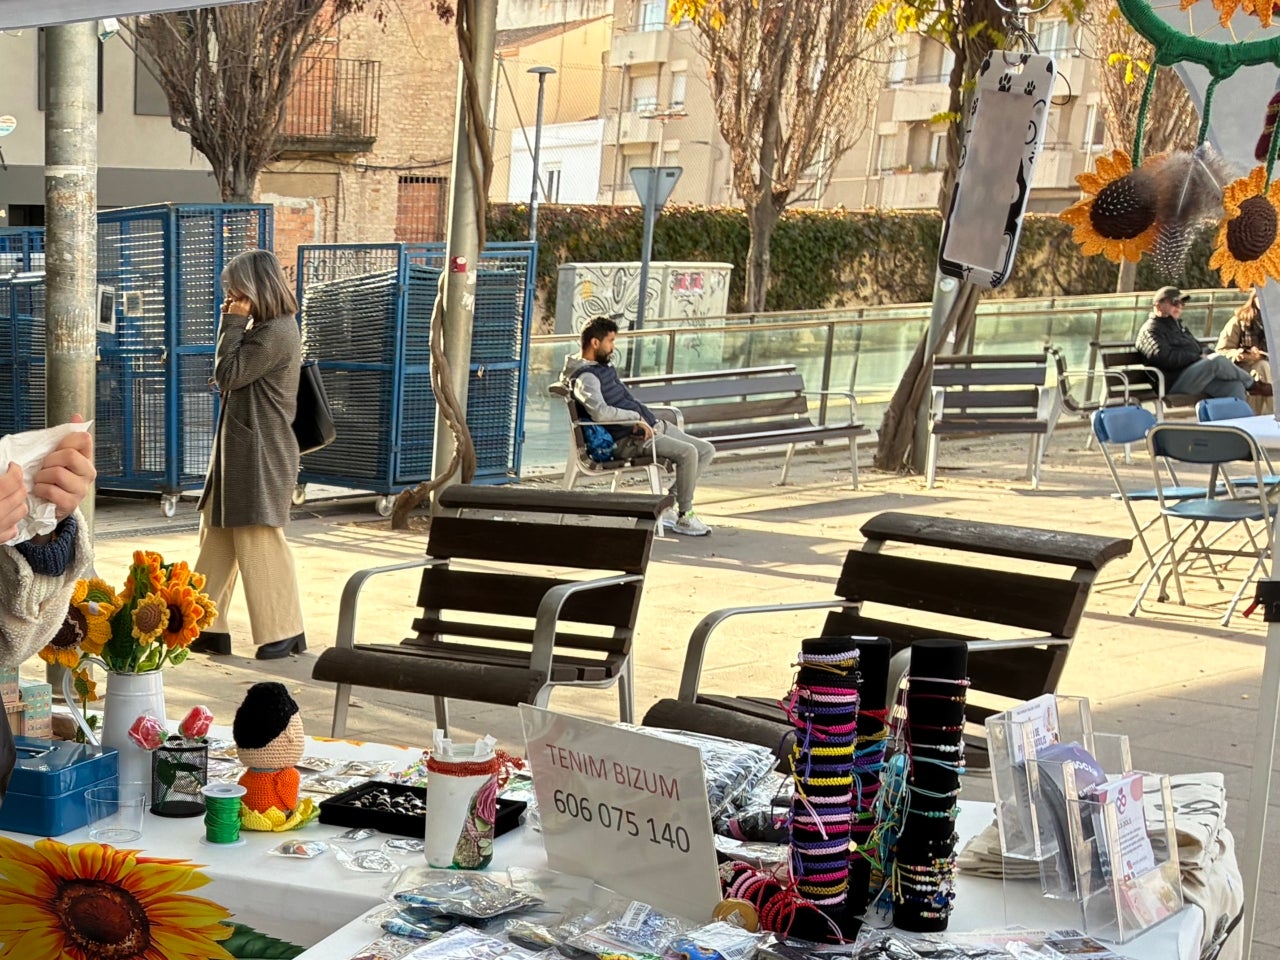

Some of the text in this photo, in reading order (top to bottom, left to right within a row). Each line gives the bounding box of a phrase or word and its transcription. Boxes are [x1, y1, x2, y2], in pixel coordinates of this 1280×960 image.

[545, 743, 681, 801] TENIM BIZUM
[553, 789, 690, 853] 606 075 140
